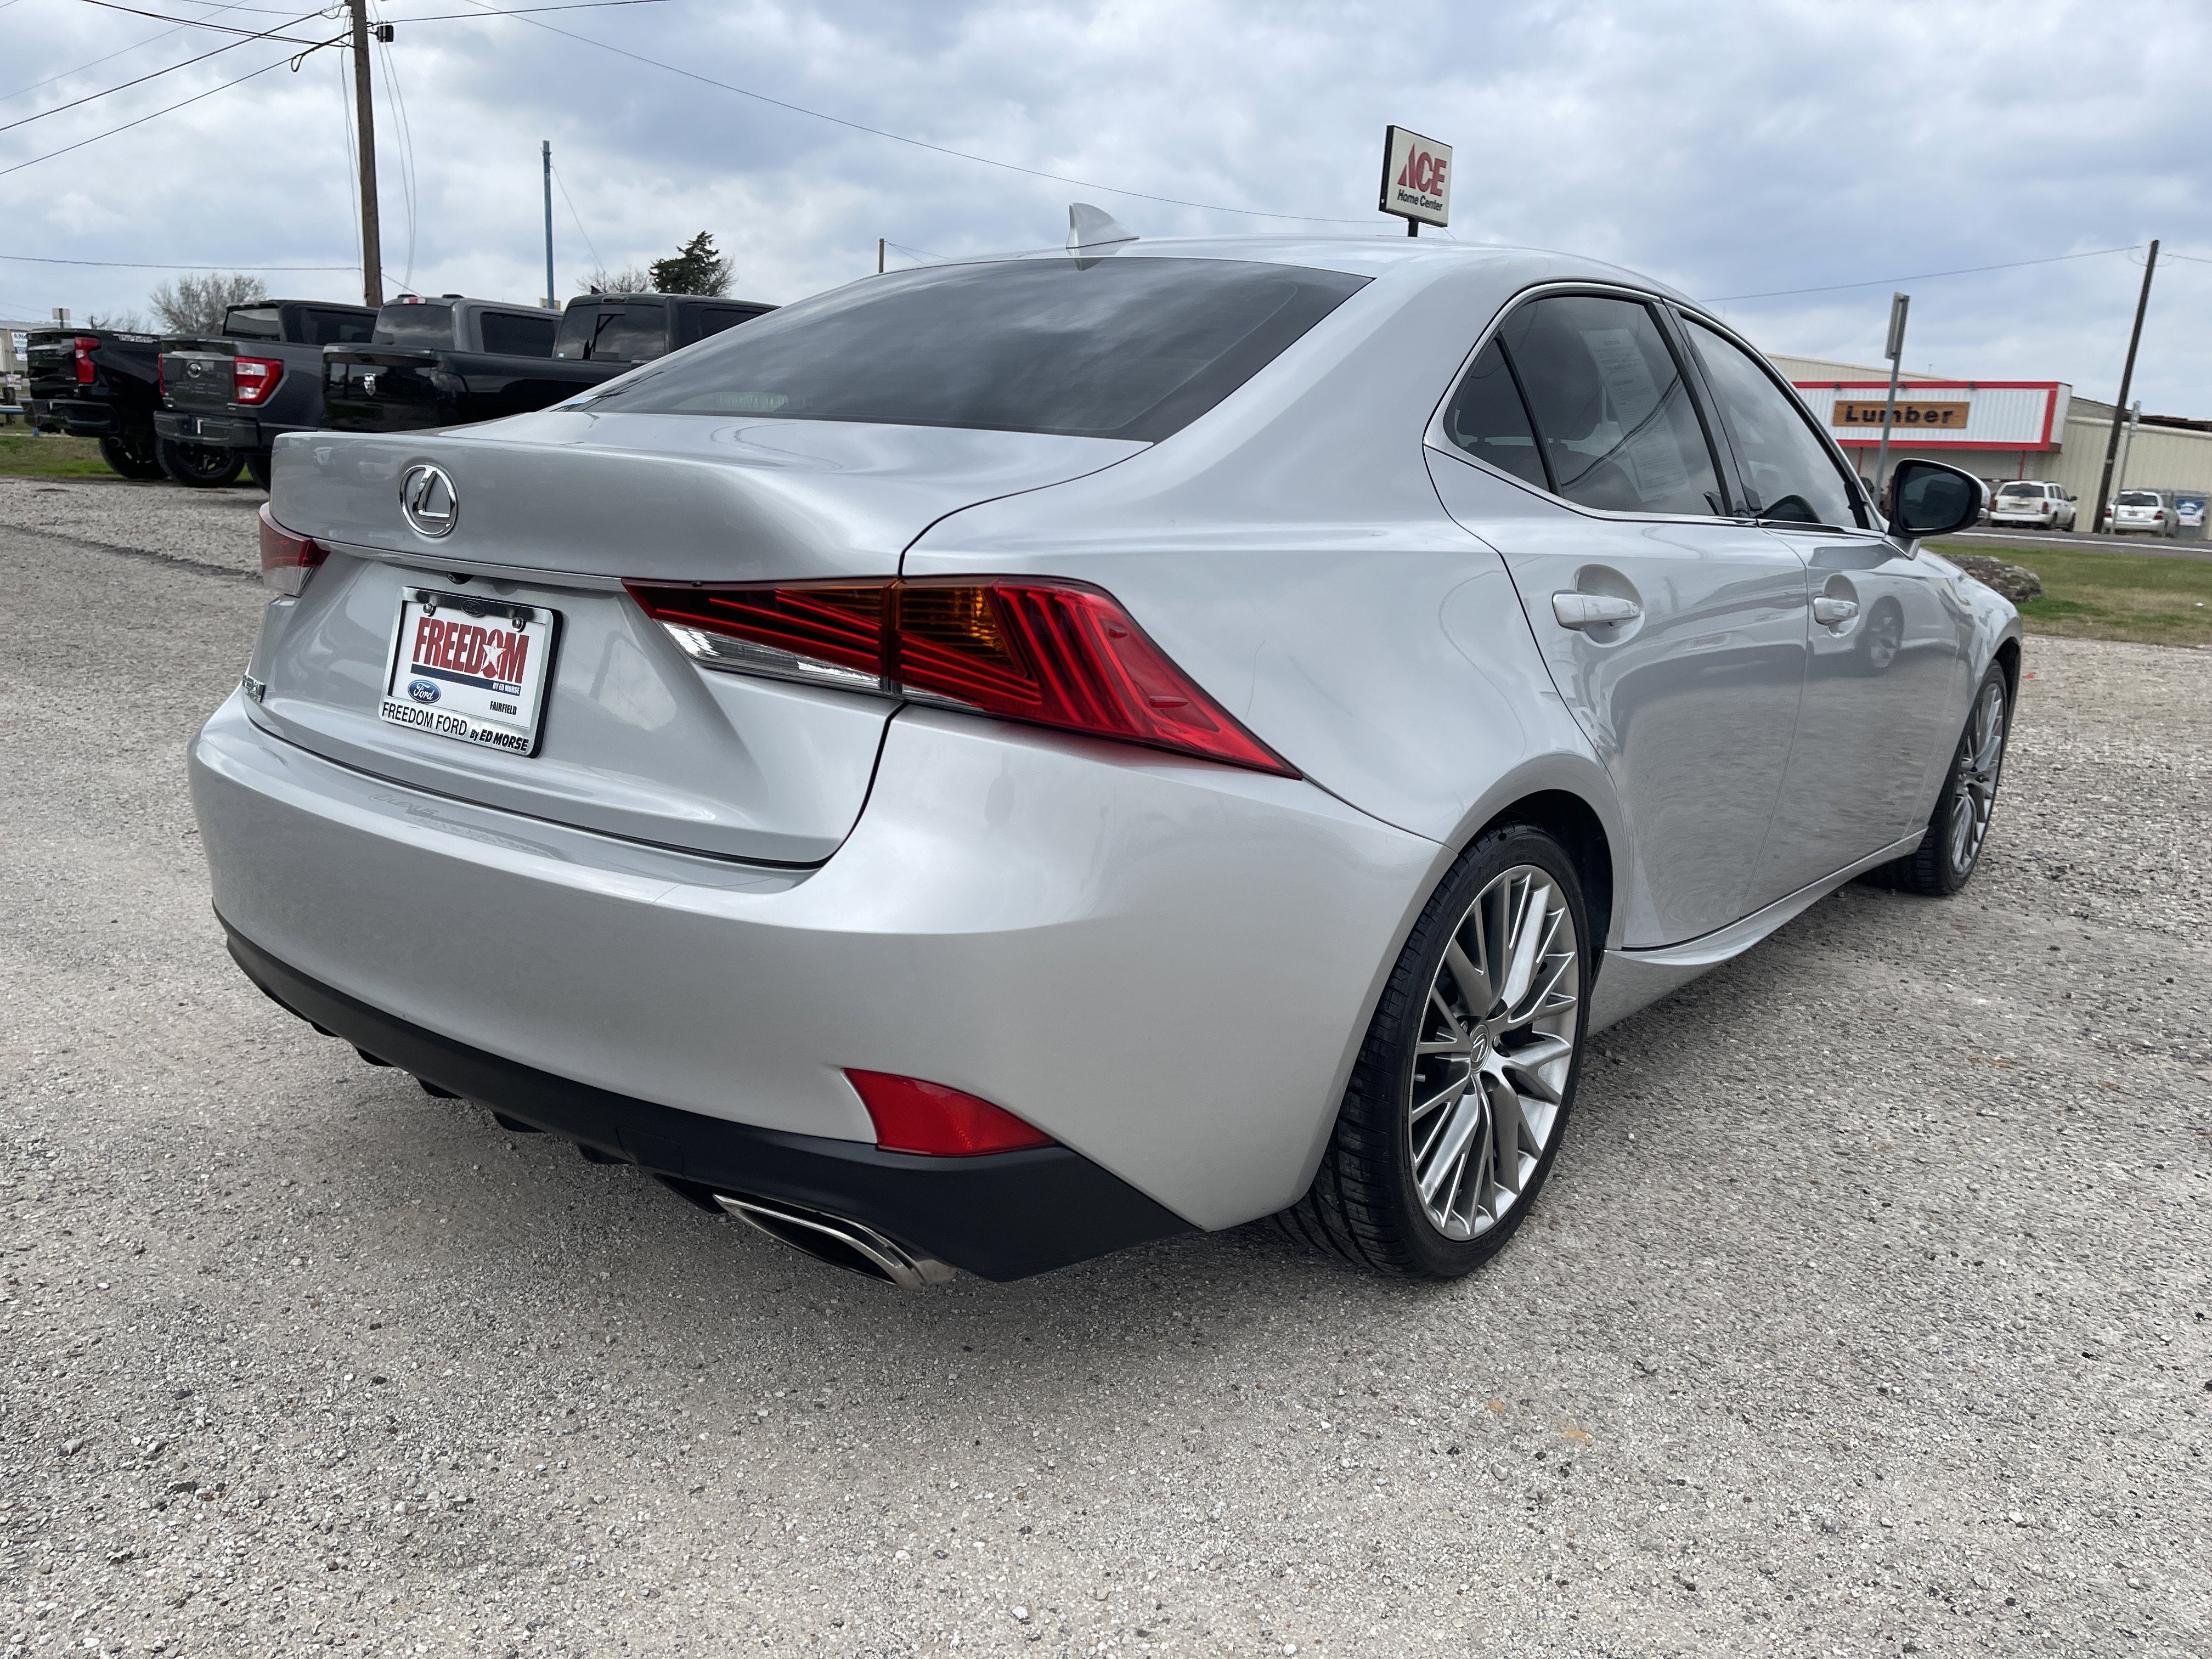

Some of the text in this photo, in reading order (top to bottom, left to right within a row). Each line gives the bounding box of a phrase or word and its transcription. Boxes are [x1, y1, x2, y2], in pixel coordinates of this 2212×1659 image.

[1397, 143, 1447, 197] ACE
[1397, 189, 1443, 212] Home Center
[1846, 405, 1954, 424] Lumber
[413, 617, 529, 684] FREEDOM
[413, 682, 435, 701] Ford
[499, 683, 505, 691] ED
[505, 684, 520, 695] MORSE
[489, 701, 517, 715] FAIRFIELD
[382, 701, 529, 752] FREEDOM FORD By ED MORSE
